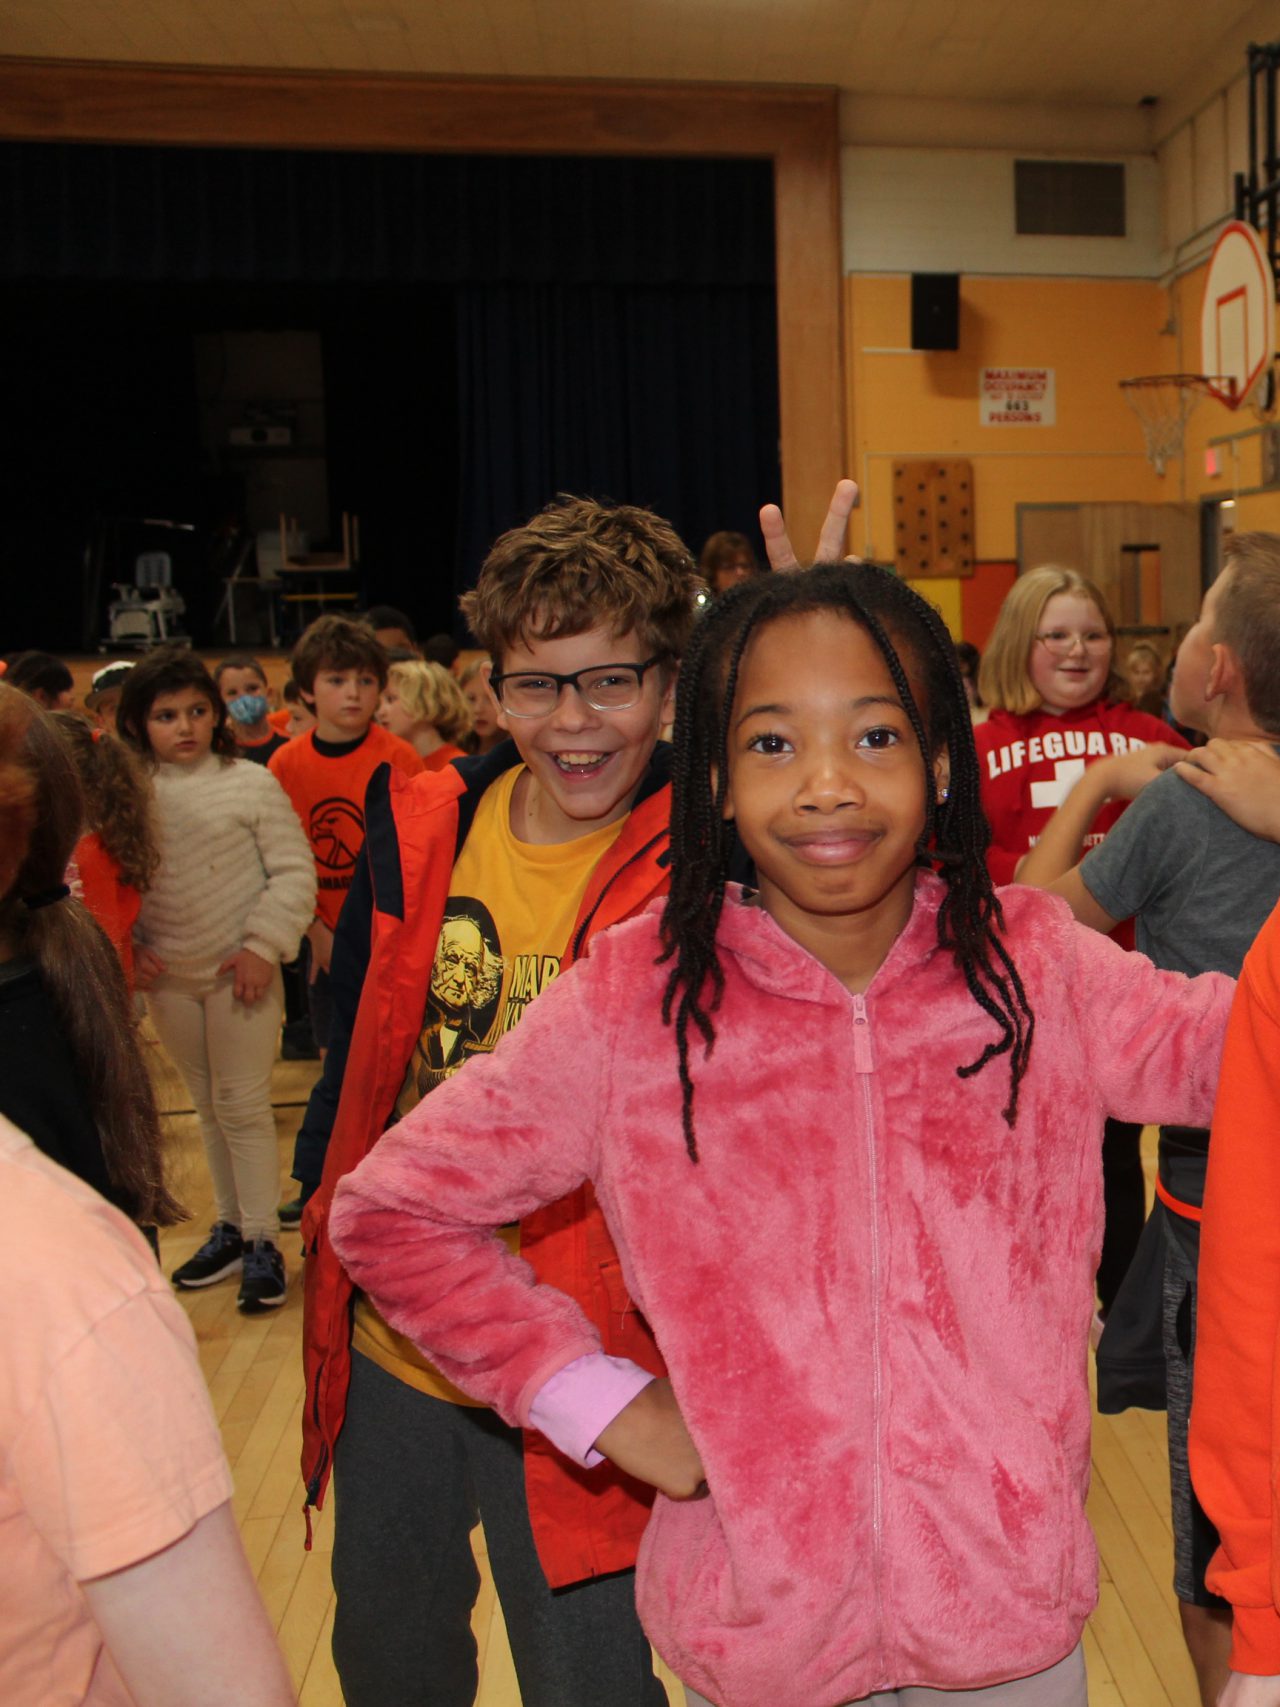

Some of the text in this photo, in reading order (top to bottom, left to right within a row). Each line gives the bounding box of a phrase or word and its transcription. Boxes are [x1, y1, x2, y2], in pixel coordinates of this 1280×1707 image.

[985, 370, 1047, 380] MAXIMUM
[984, 381, 1046, 391] OCCUPANCY
[989, 411, 1041, 422] PERSONS
[509, 954, 561, 1001] MAR
